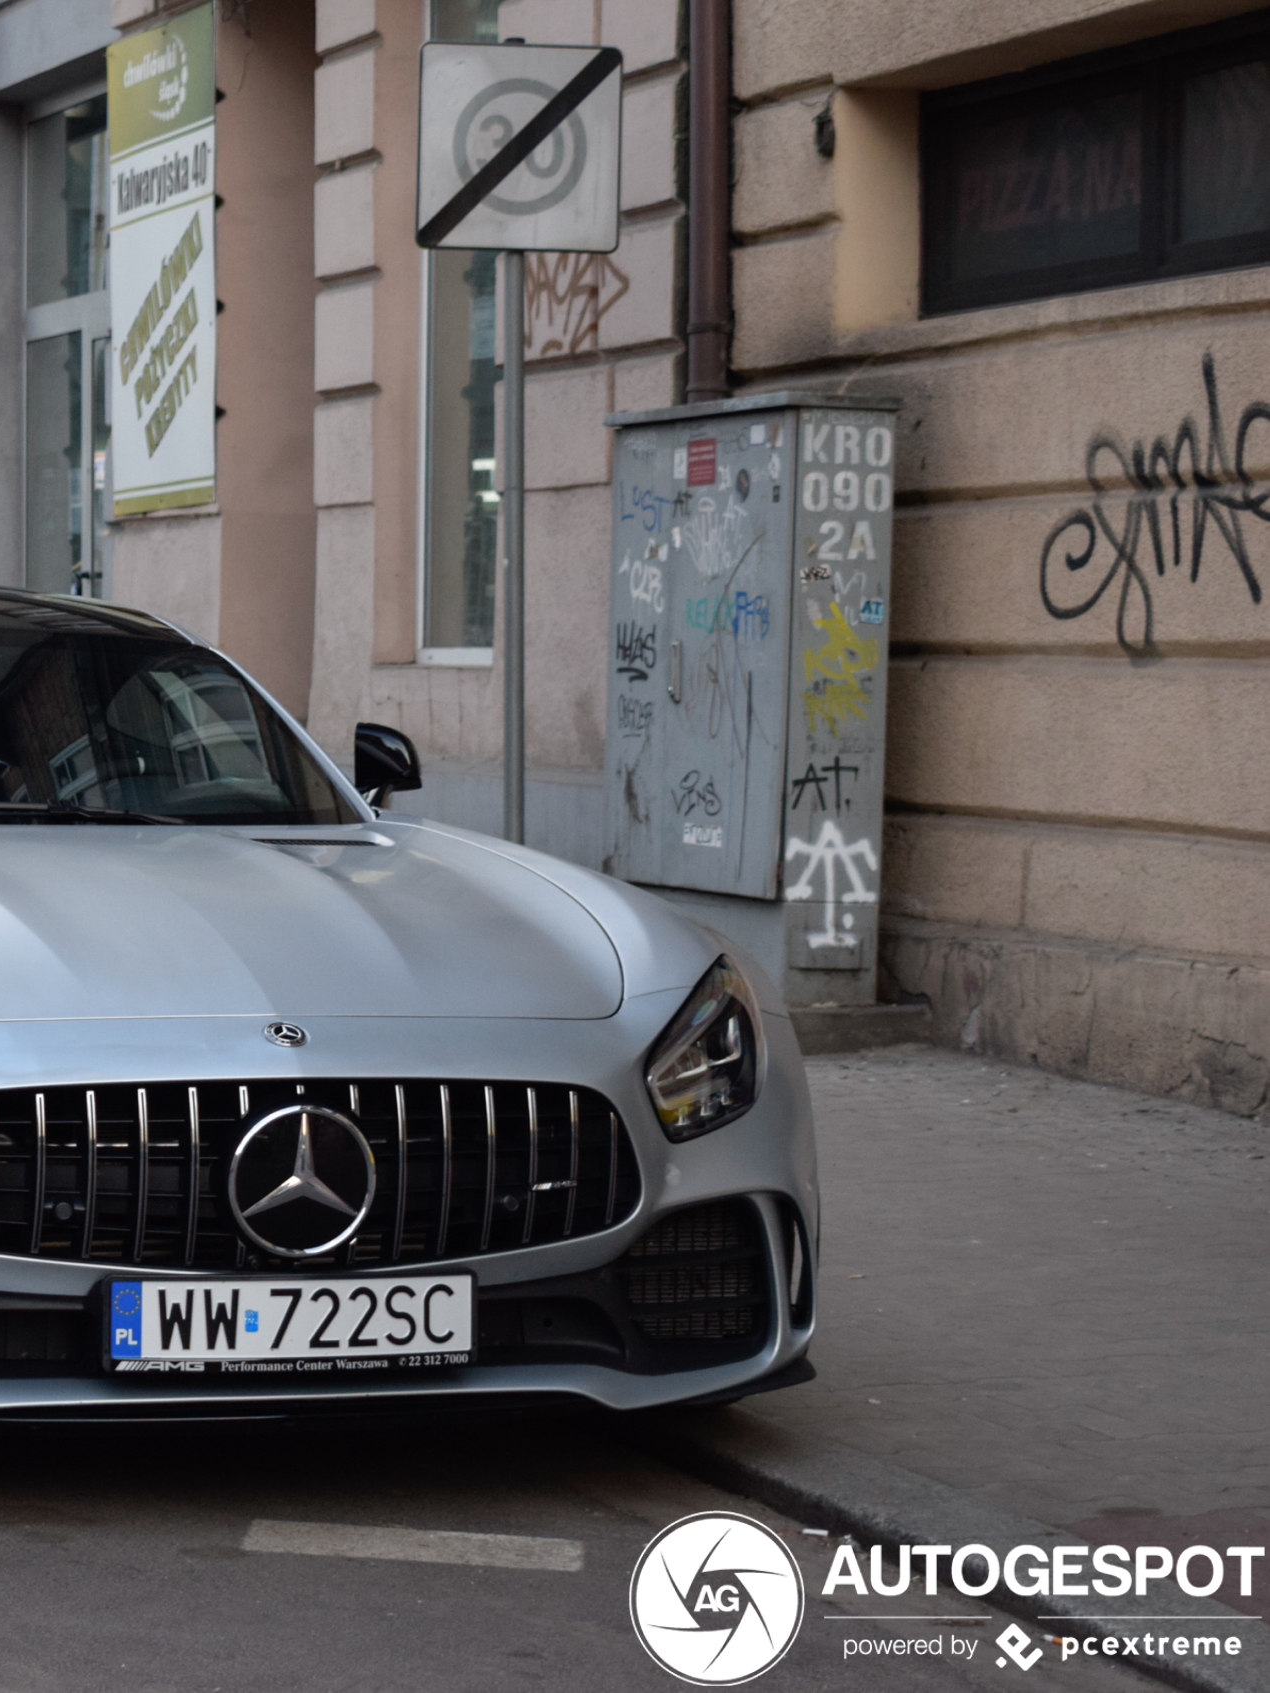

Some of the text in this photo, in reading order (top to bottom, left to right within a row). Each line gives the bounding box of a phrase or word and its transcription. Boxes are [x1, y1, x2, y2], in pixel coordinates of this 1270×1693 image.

[117, 141, 207, 214] Kalwaryjska 40
[957, 149, 1071, 237] PIZZA
[803, 424, 892, 468] KRO
[802, 470, 892, 513] 090
[817, 520, 876, 561] 2A
[115, 1328, 138, 1346] PL
[158, 1284, 455, 1350] WW 722SC
[221, 1361, 293, 1372] Performance
[296, 1360, 333, 1371] Center
[336, 1358, 388, 1370] Warszawa
[408, 1356, 421, 1366] 22
[424, 1355, 441, 1366] 312
[444, 1353, 469, 1364] 7000
